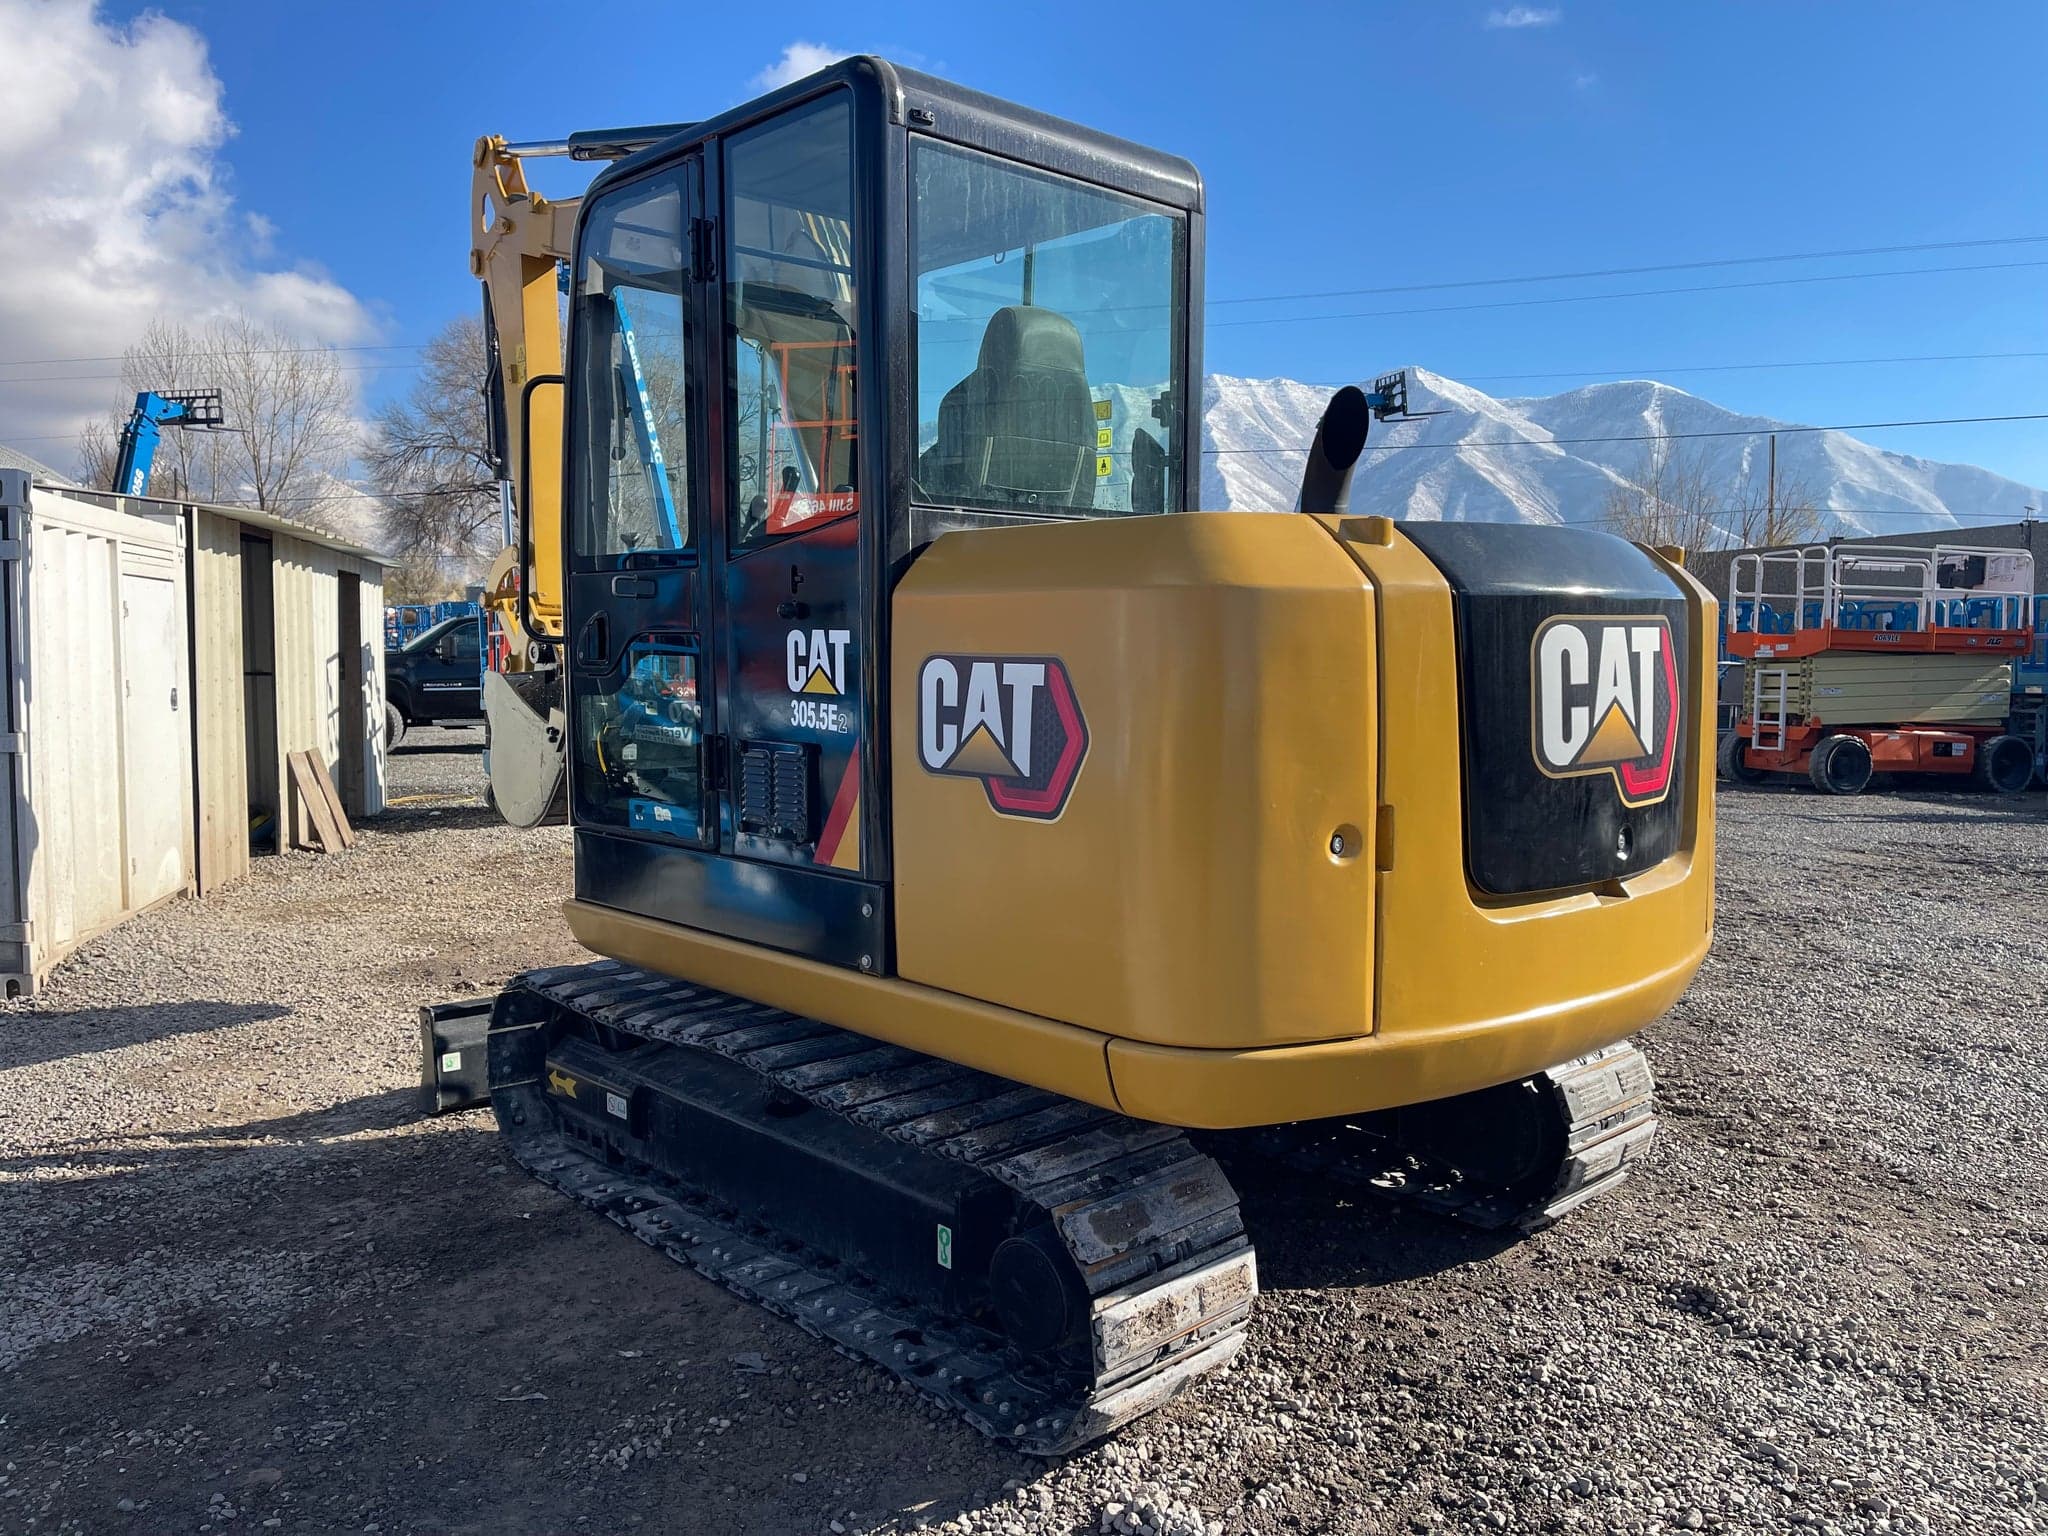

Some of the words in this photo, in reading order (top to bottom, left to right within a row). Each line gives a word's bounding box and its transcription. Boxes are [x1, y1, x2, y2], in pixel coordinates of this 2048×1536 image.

[626, 330, 641, 380] Genie
[650, 439, 663, 464] XC
[787, 630, 850, 695] CAT
[1541, 624, 1660, 766] CAT
[1986, 637, 2002, 645] JLG
[922, 658, 1045, 777] CAT
